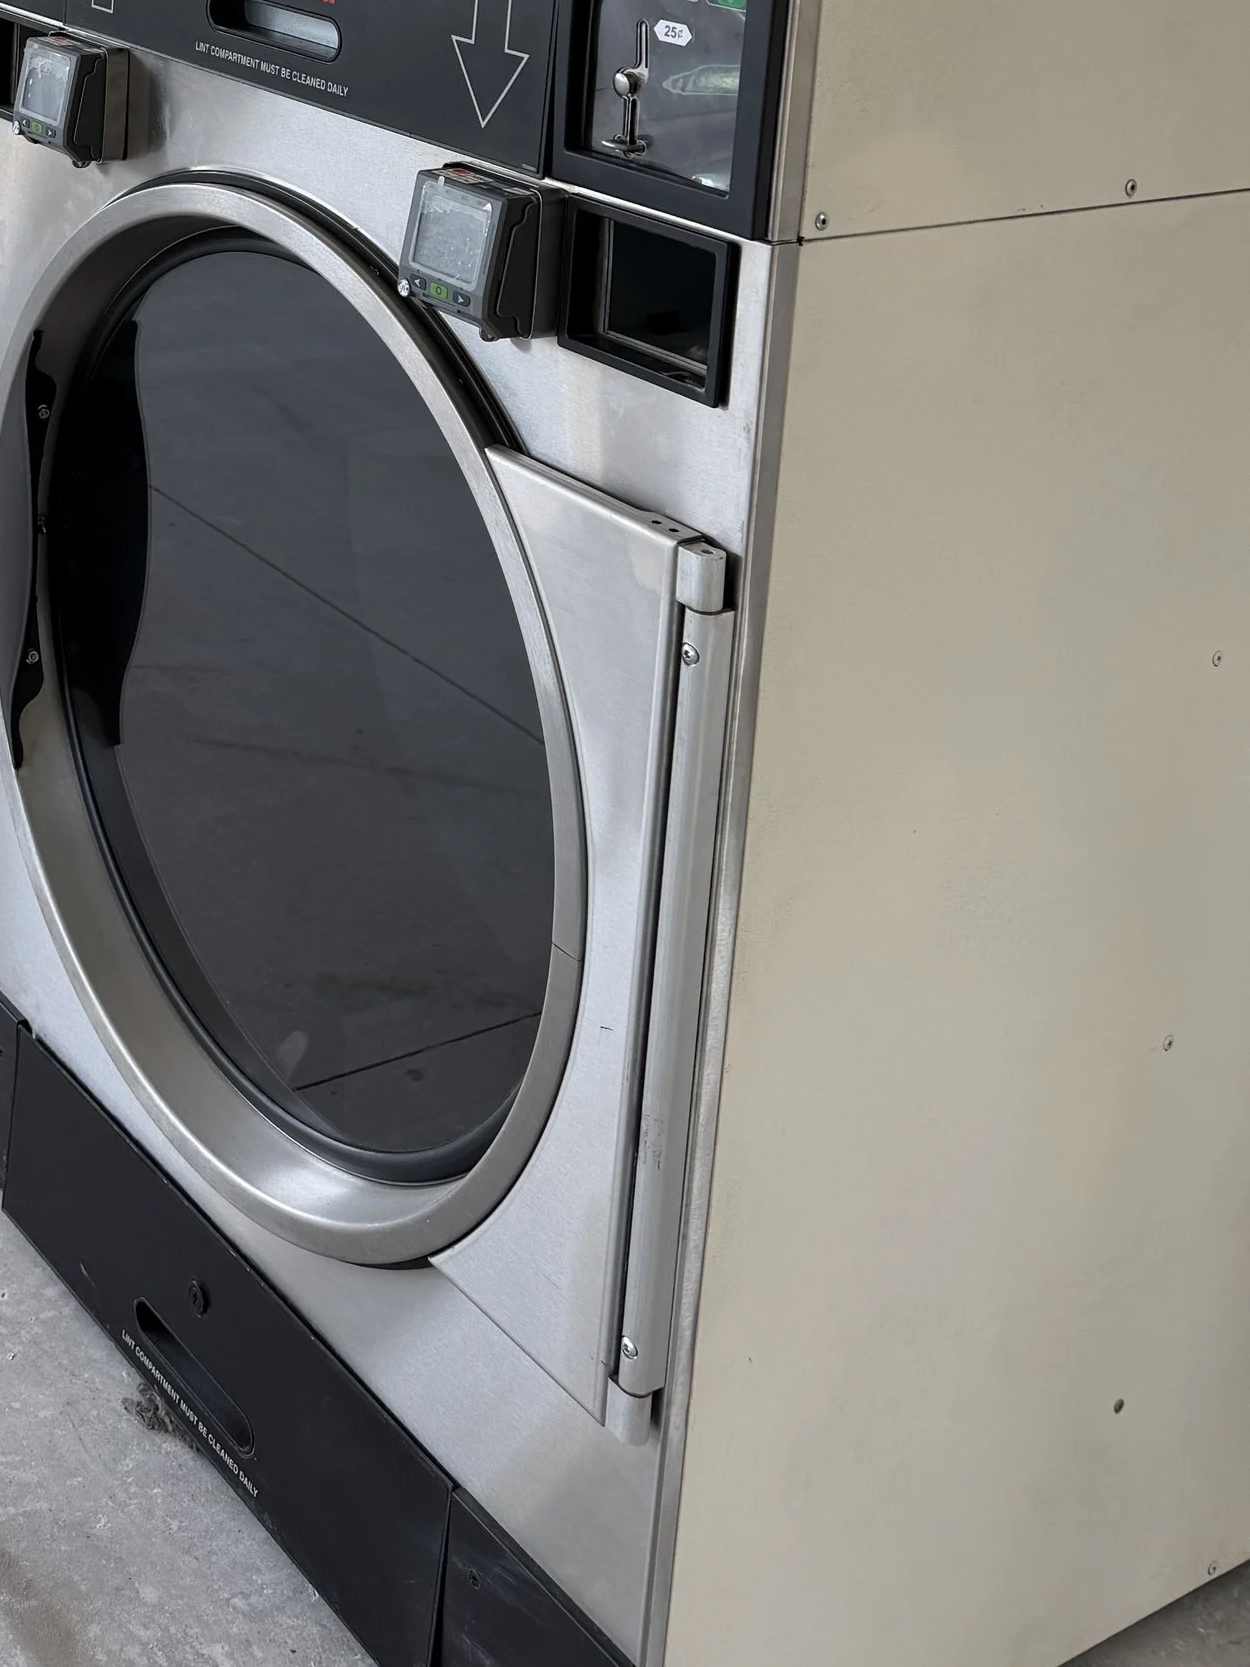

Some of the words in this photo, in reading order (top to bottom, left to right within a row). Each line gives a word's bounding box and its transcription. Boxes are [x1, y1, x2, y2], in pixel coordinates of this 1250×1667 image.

[664, 25, 684, 39] 25¢
[195, 41, 209, 54] LINT
[210, 45, 260, 69] COMPARTMENT
[260, 61, 279, 76] MUST
[281, 67, 290, 79] BE
[292, 70, 325, 90] CLEANED
[328, 82, 348, 97] DAILY
[122, 1329, 136, 1349] LINT
[135, 1346, 180, 1404] COMPARTMENT
[180, 1400, 197, 1425] MUST
[198, 1422, 207, 1438] BE
[208, 1434, 238, 1475] CLEANED
[239, 1470, 258, 1497] DAILY
